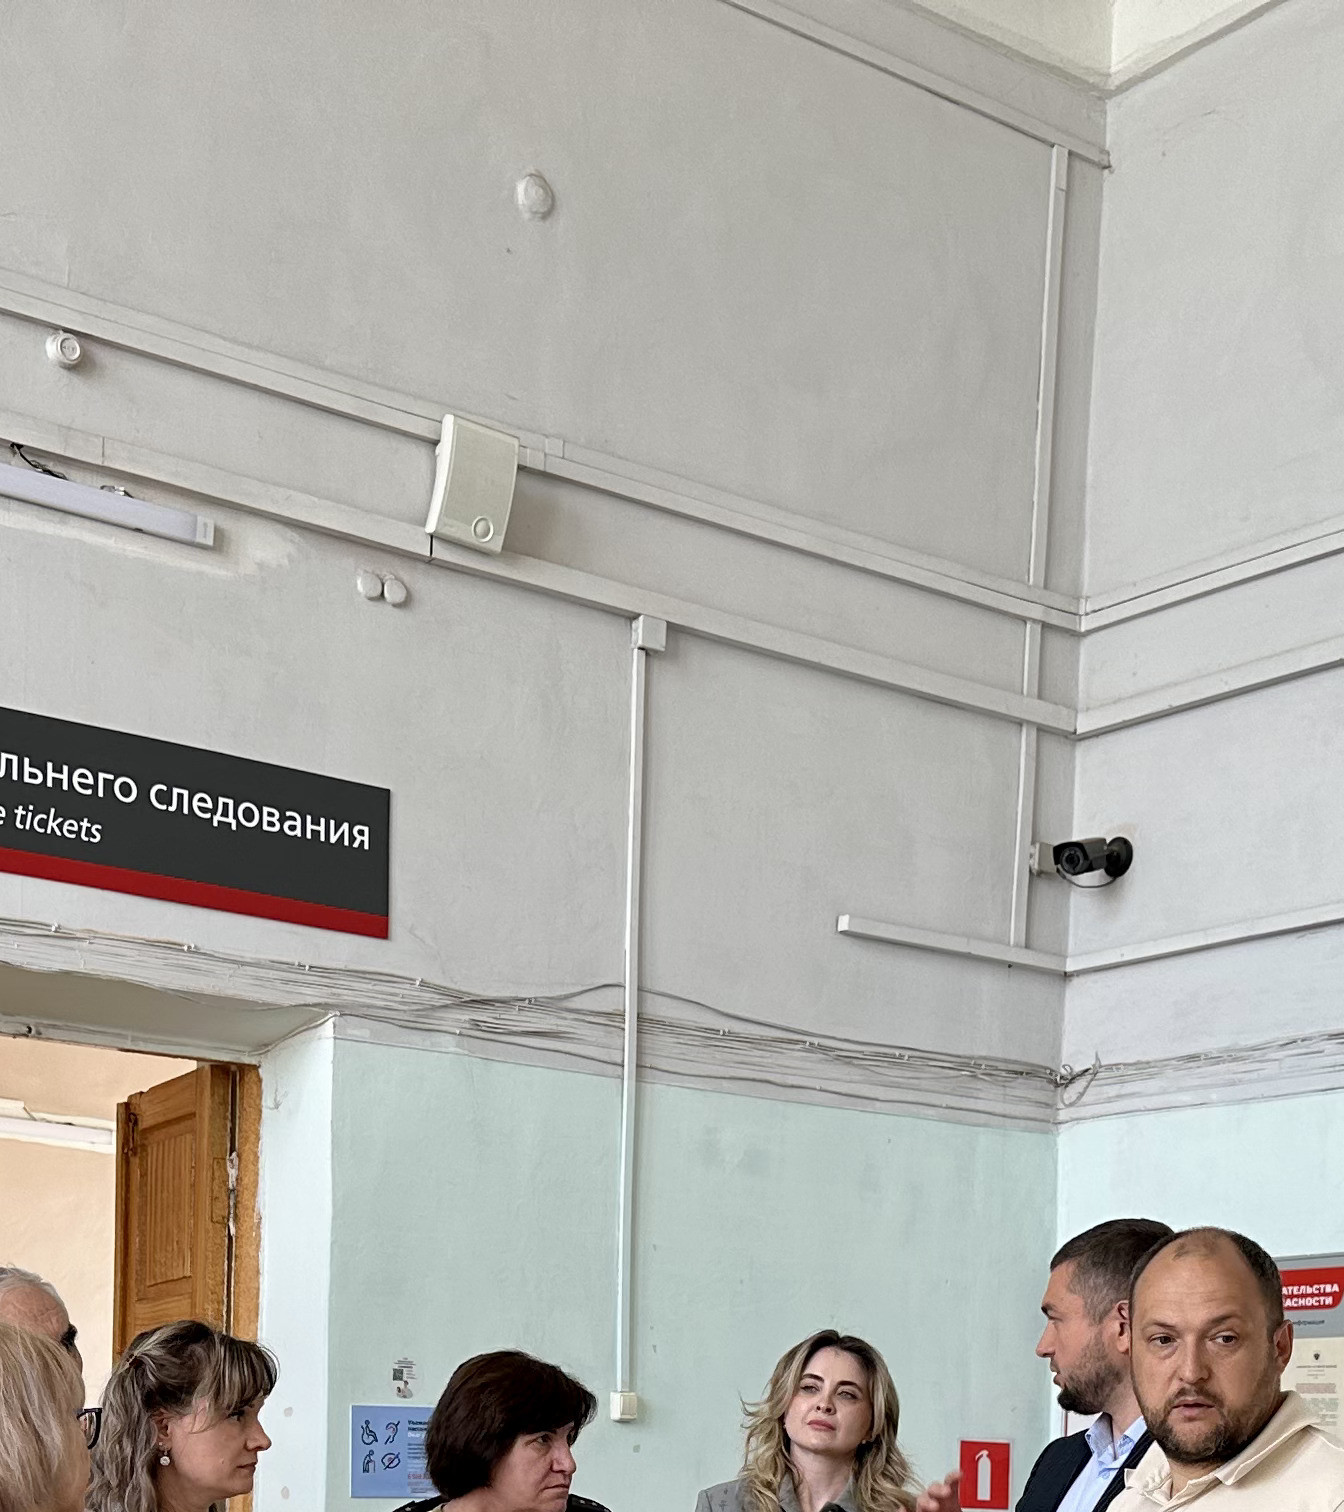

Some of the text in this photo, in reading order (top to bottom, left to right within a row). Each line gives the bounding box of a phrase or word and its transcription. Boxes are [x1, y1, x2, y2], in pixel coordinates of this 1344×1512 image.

[14, 804, 103, 843] tickets
[149, 783, 370, 850] следования
[1282, 1283, 1339, 1295] АТЕЛЬСТВА
[1282, 1296, 1333, 1307] АСНОСТИ
